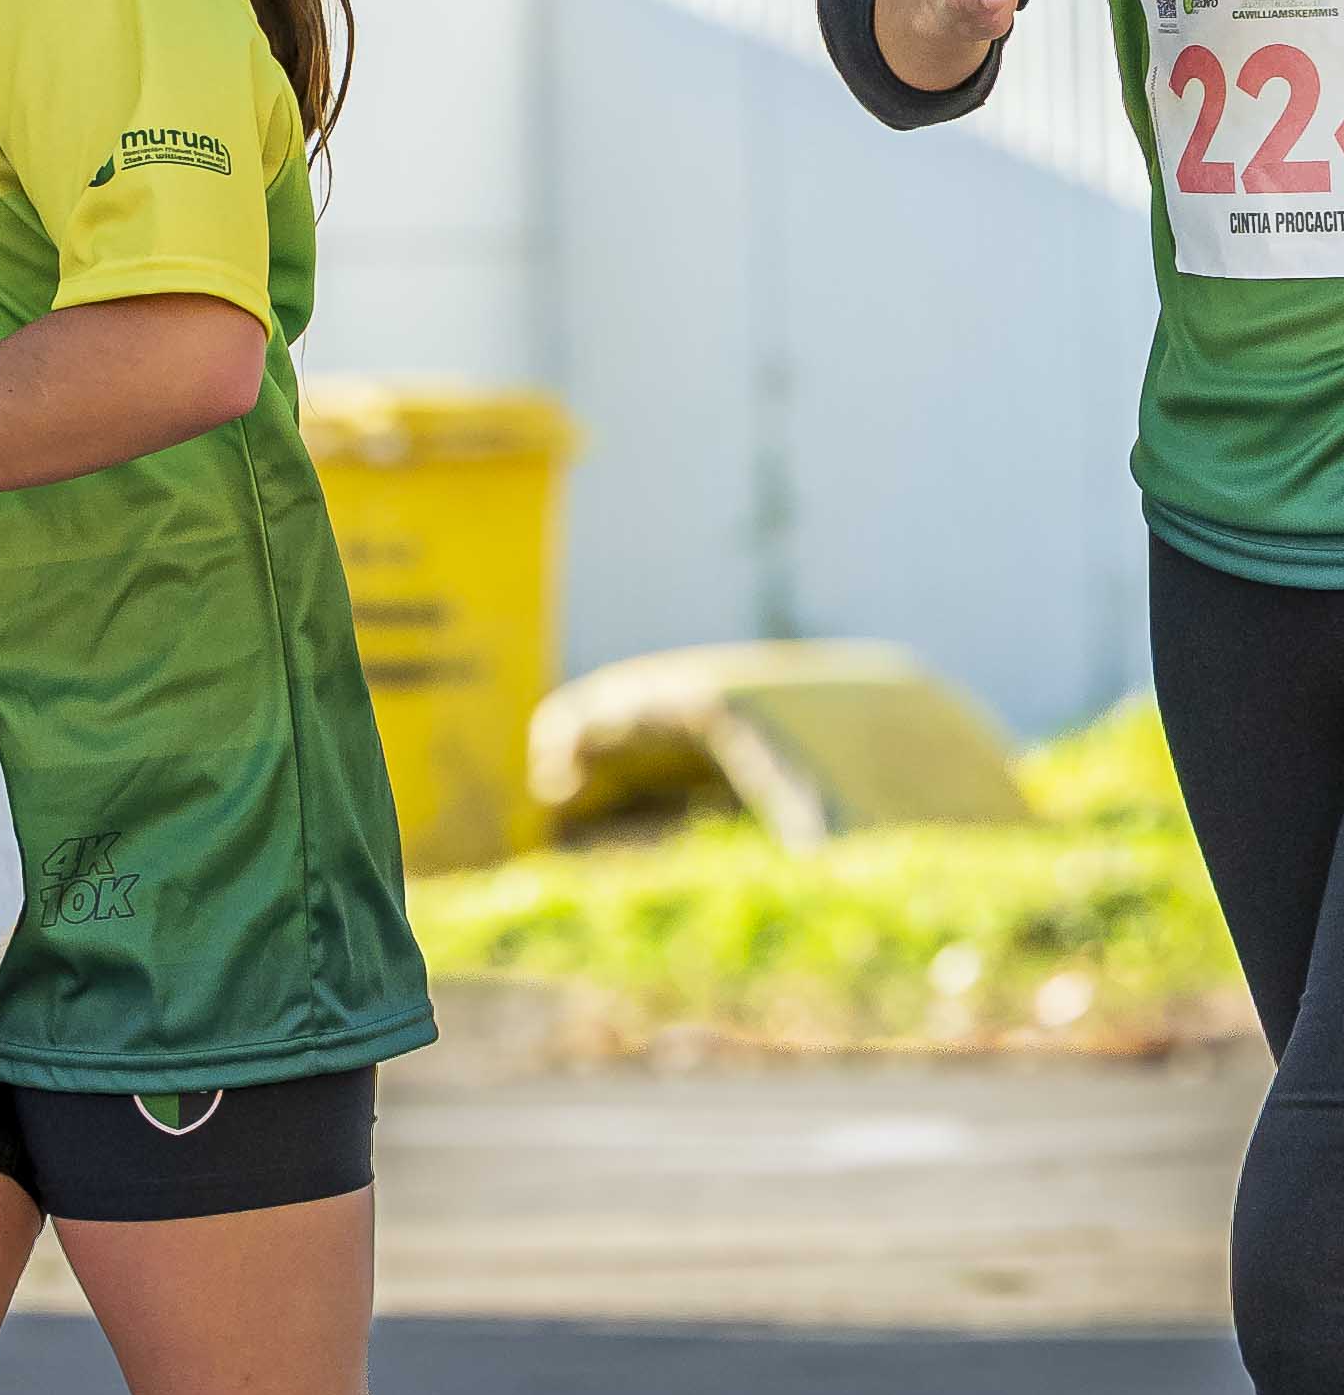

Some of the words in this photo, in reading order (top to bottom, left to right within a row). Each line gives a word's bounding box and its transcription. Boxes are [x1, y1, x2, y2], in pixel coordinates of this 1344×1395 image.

[1229, 212, 1271, 234] CINTIA
[42, 831, 122, 881] 4K
[40, 874, 140, 928] 10K
